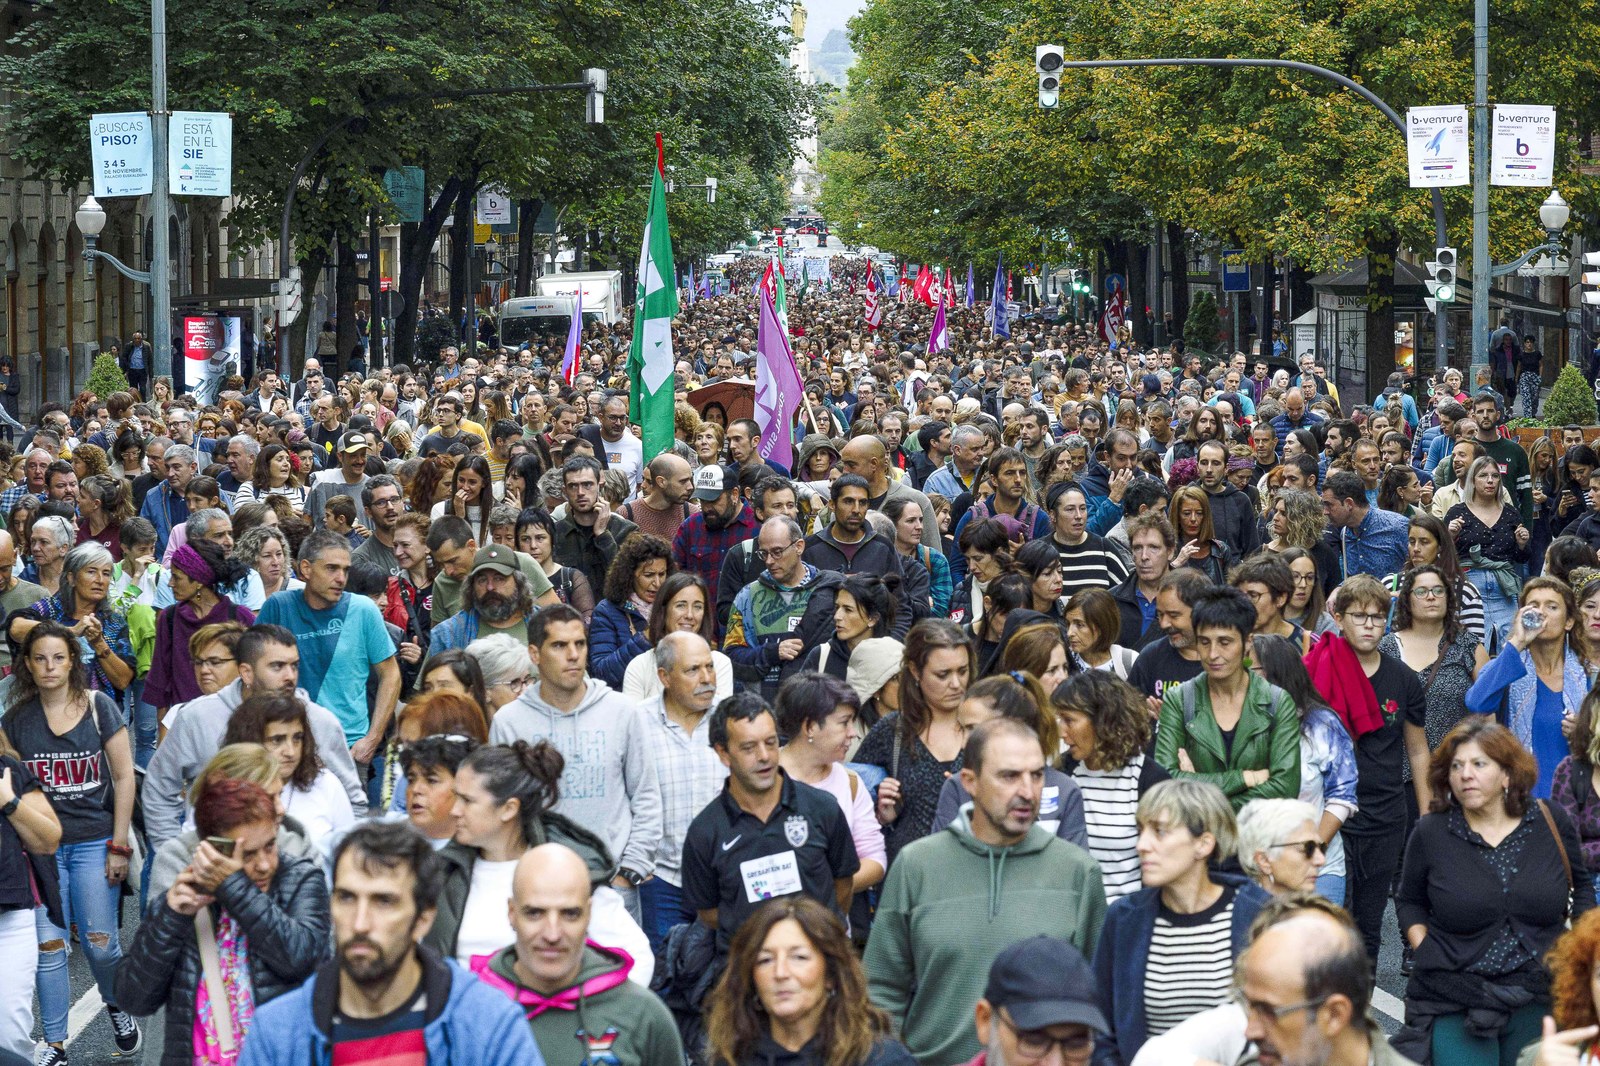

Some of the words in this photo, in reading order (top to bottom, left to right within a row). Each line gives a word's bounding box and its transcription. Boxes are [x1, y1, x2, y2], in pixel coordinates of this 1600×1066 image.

[94, 122, 144, 136] ¿BUSCAS
[184, 122, 212, 134] ESTÁ
[102, 134, 138, 146] PISO?
[184, 136, 200, 146] EN
[204, 137, 218, 148] EL
[1516, 138, 1530, 156] b
[184, 149, 204, 159] SIE
[104, 160, 110, 168] 3
[120, 160, 126, 168] 5
